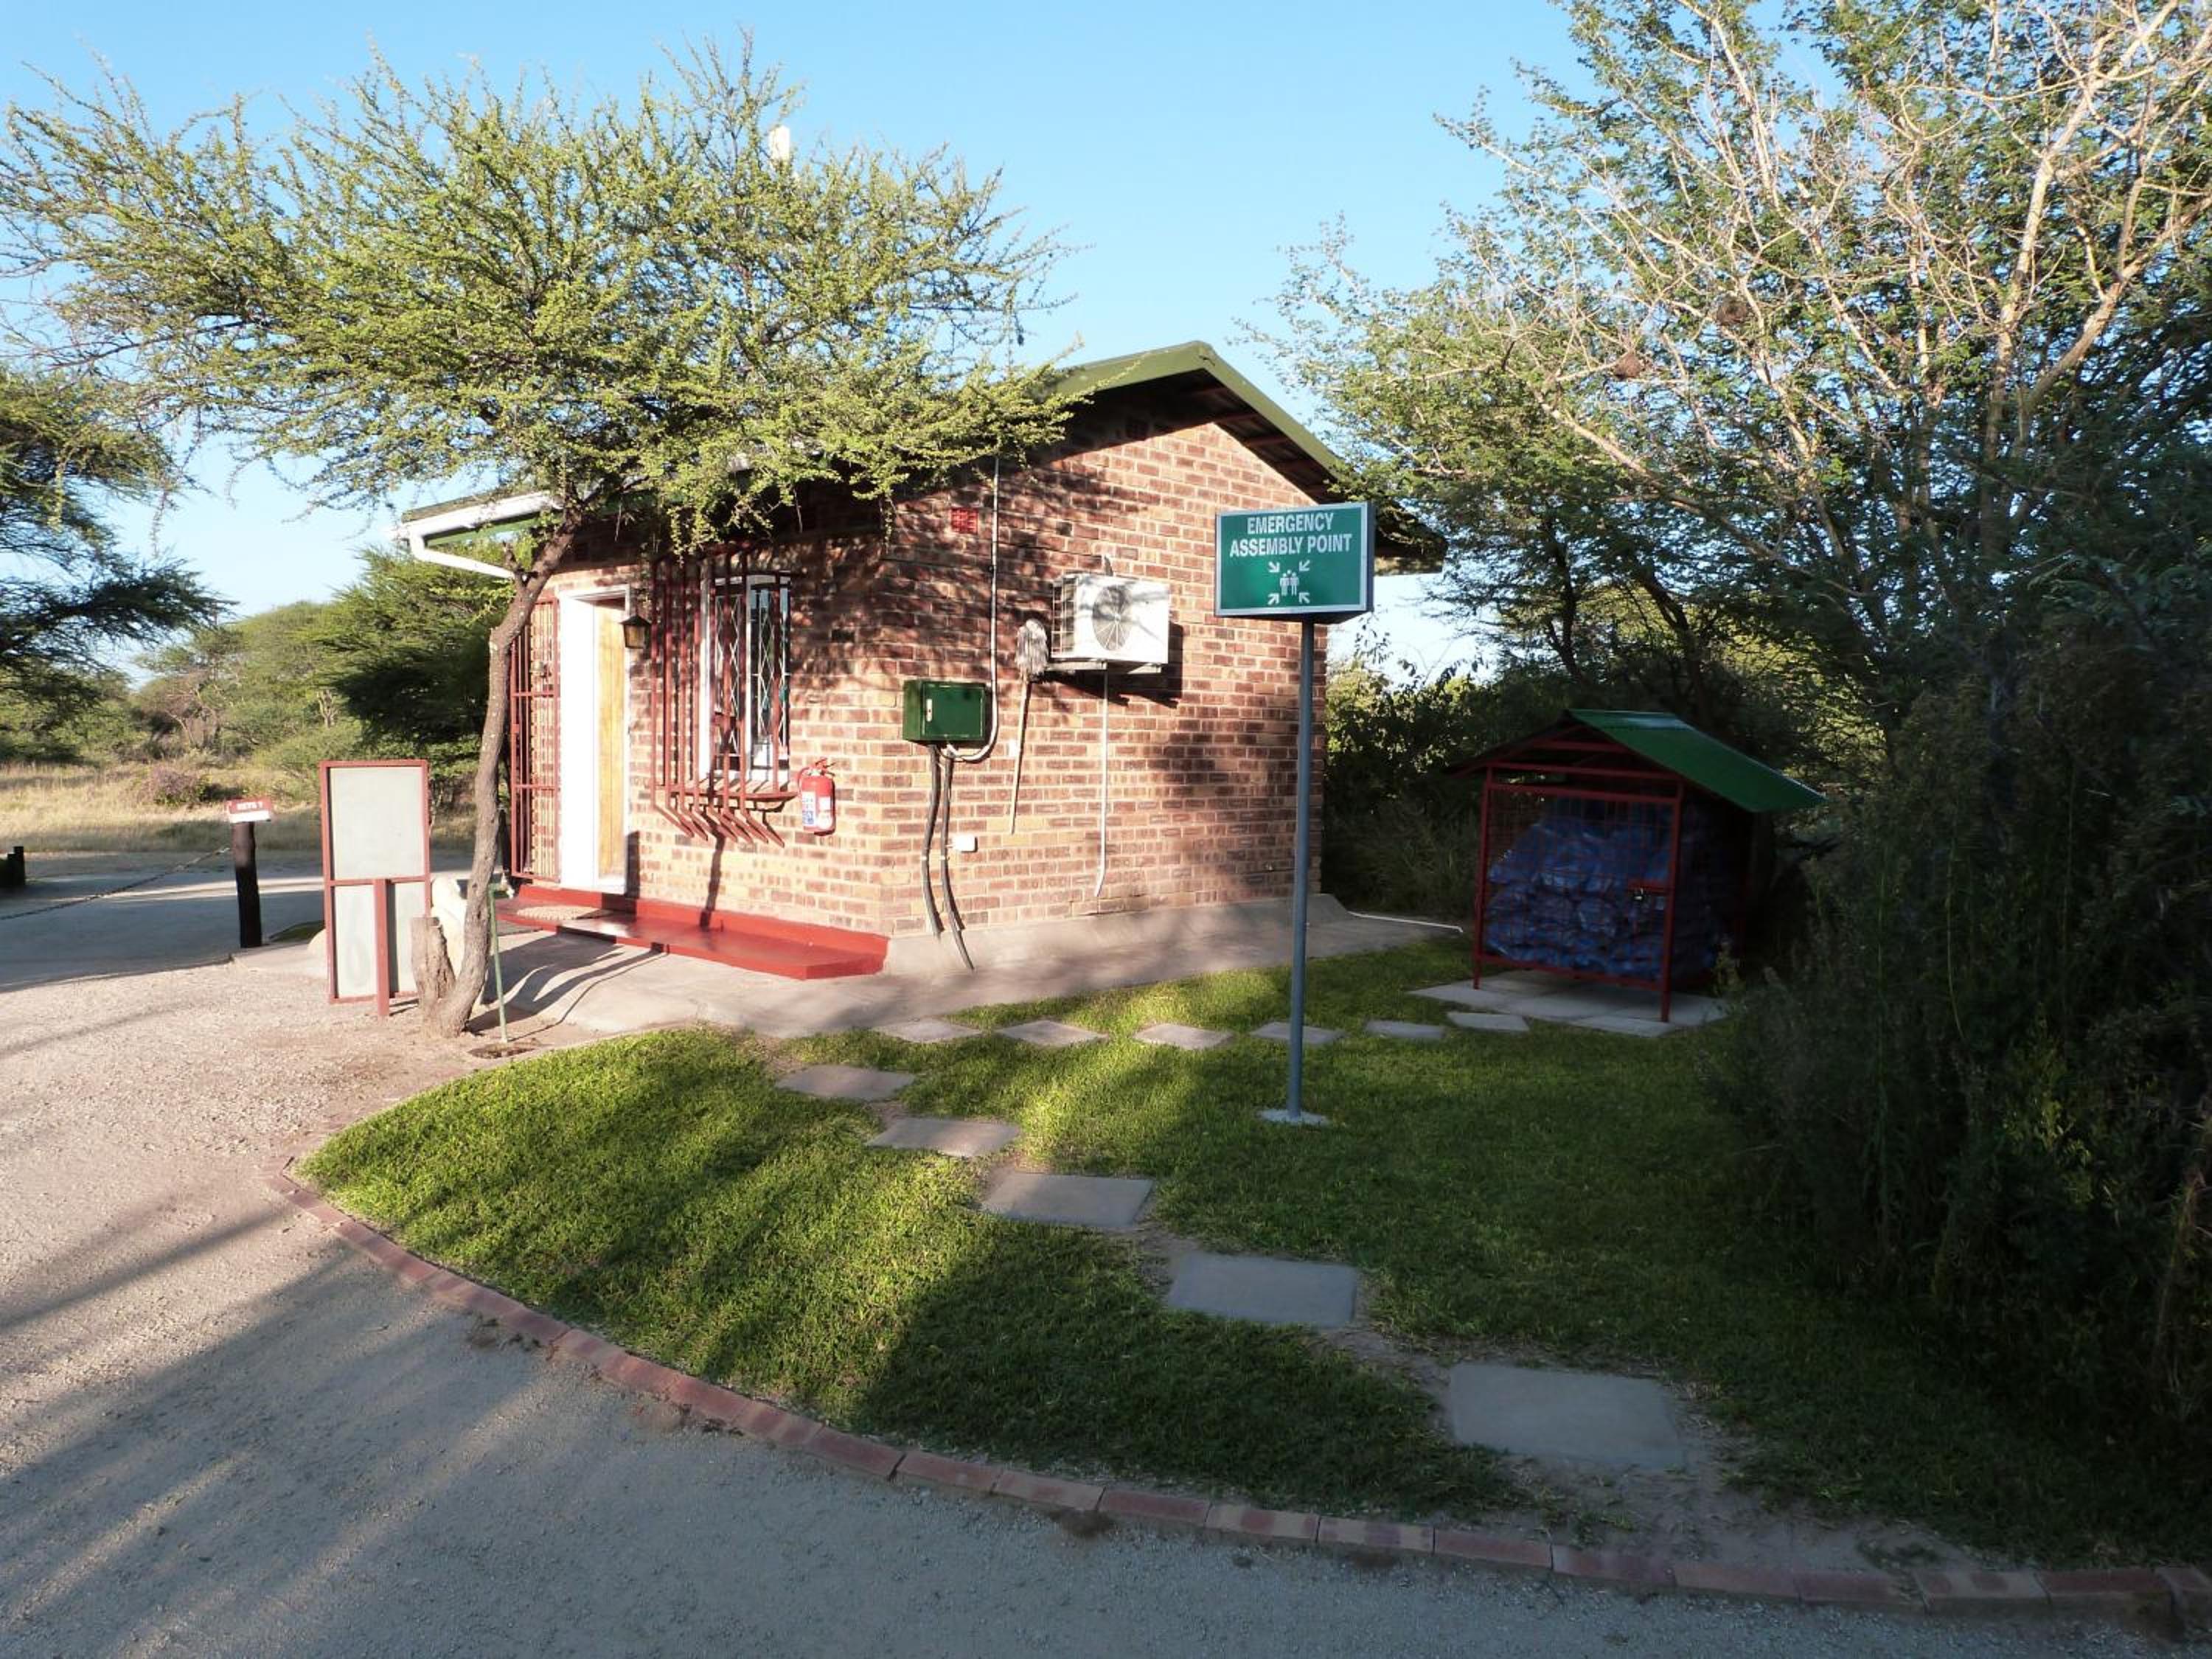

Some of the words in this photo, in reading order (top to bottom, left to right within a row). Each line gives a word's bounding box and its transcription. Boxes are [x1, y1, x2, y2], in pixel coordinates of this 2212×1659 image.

[1248, 513, 1333, 535] EMERGENCY
[1230, 537, 1304, 557] ASSEMBLY
[1308, 534, 1352, 553] POINT
